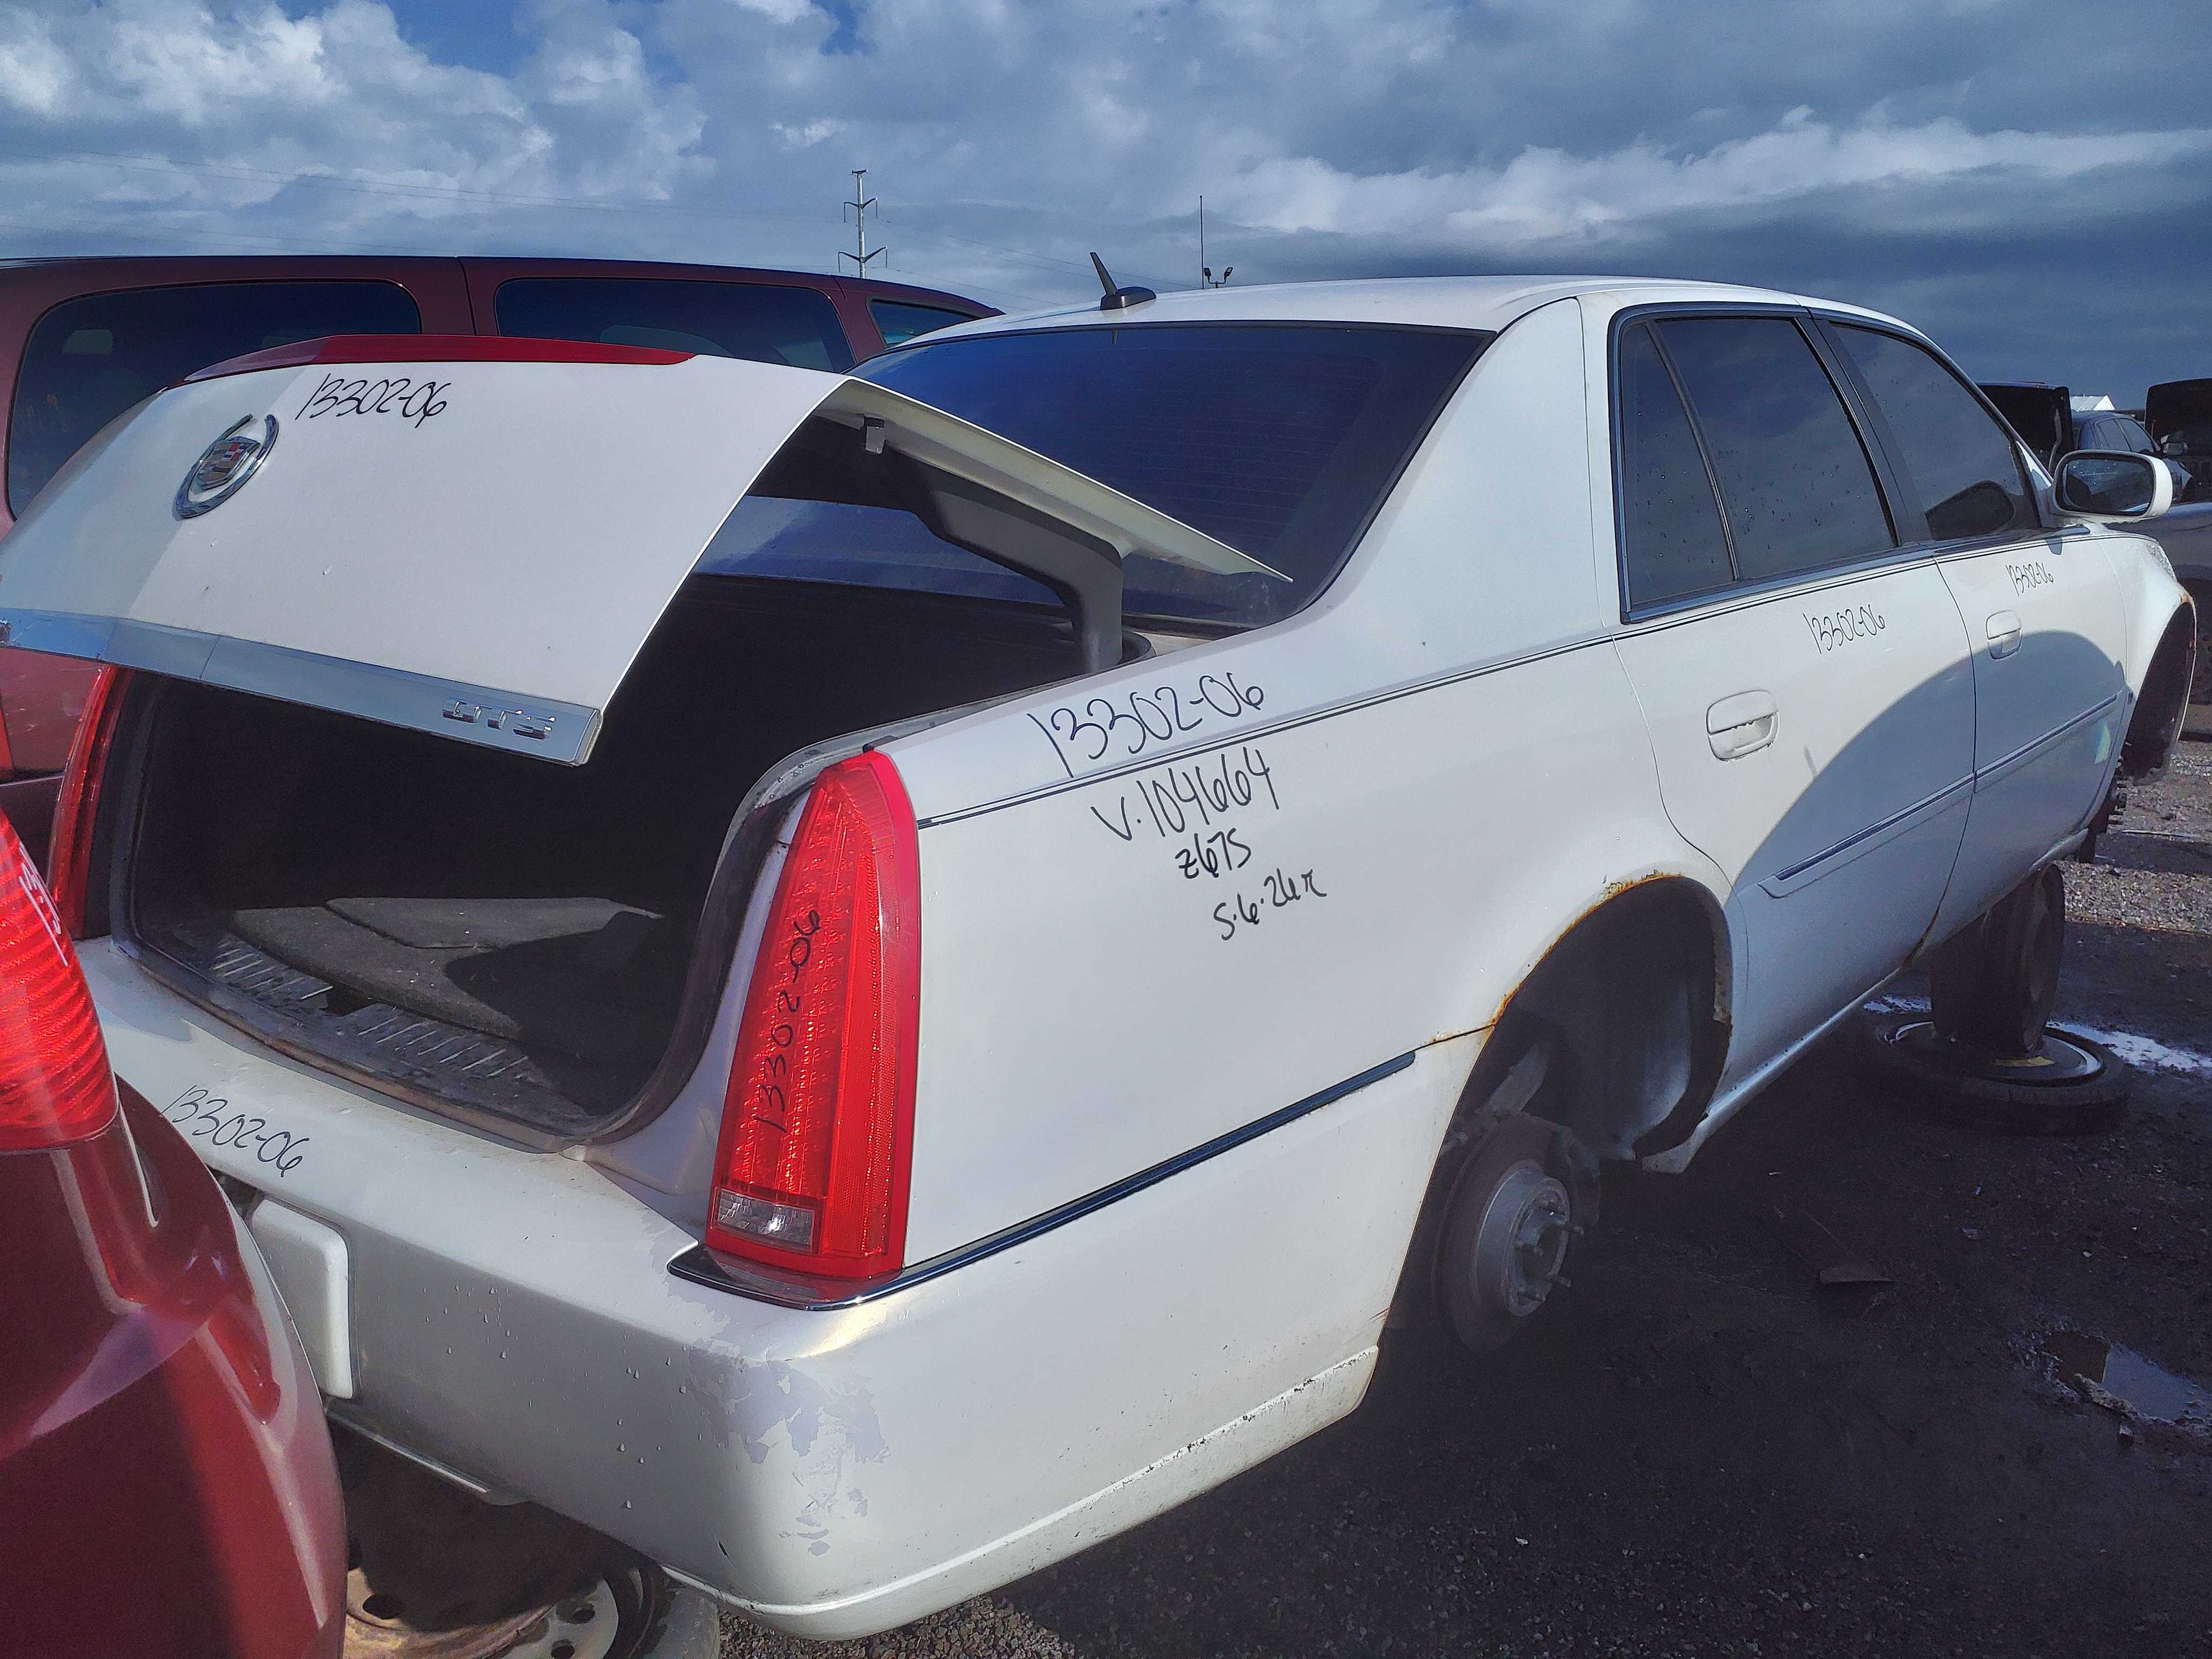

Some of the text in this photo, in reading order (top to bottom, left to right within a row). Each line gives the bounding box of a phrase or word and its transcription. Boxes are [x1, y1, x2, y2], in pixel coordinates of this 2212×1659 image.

[295, 373, 451, 429] 13302-06
[2005, 561, 2054, 596] 13302-06
[1803, 604, 1886, 654] 13302-06
[1026, 672, 1265, 779] 13302-06
[754, 909, 821, 1131] 13302-06
[161, 1085, 310, 1177] 13302-06
